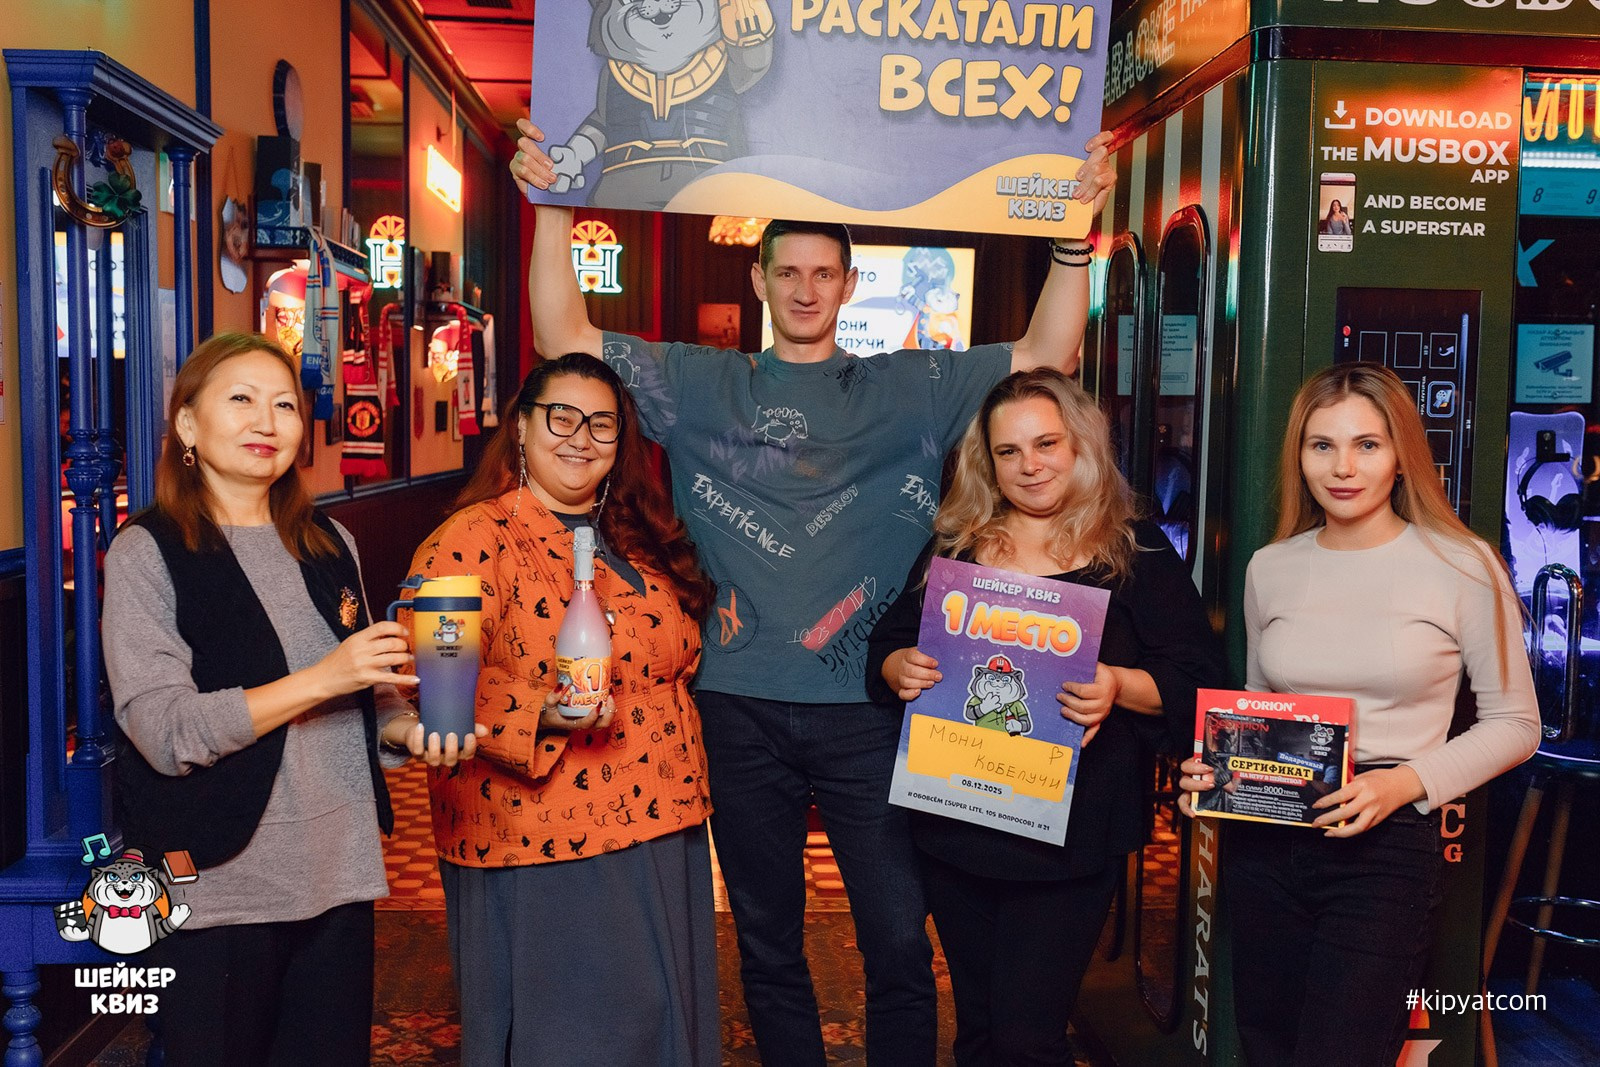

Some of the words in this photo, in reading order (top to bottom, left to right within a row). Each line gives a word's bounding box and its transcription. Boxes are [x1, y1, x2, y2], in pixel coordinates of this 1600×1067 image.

[790, 0, 1095, 50] РАСКАТАЛИ
[879, 53, 1083, 123] ВСЕХ!
[1365, 107, 1512, 130] DOWNLOAD
[1320, 146, 1358, 162] THE
[1363, 136, 1511, 166] MUSBOX
[1470, 169, 1510, 184] APP
[1008, 198, 1066, 222] КВИЗ
[1364, 194, 1405, 209] AND
[1409, 195, 1486, 211] BECOME
[1362, 220, 1377, 234] A
[1380, 220, 1486, 237] SUPERSTAR
[838, 320, 868, 332] ОНИ
[805, 483, 860, 537] DESTROY
[973, 577, 1023, 596] ШЕЙКЕР
[1026, 587, 1061, 604] КВИЗ
[944, 592, 967, 634] 1
[968, 603, 1080, 655] МЕСТО
[586, 662, 601, 692] 1
[1231, 759, 1311, 778] СЕРТИФИКАТ
[961, 778, 1003, 796] 08.12.2025
[1263, 785, 1284, 796] 9000
[1192, 821, 1214, 1057] HARAT'S
